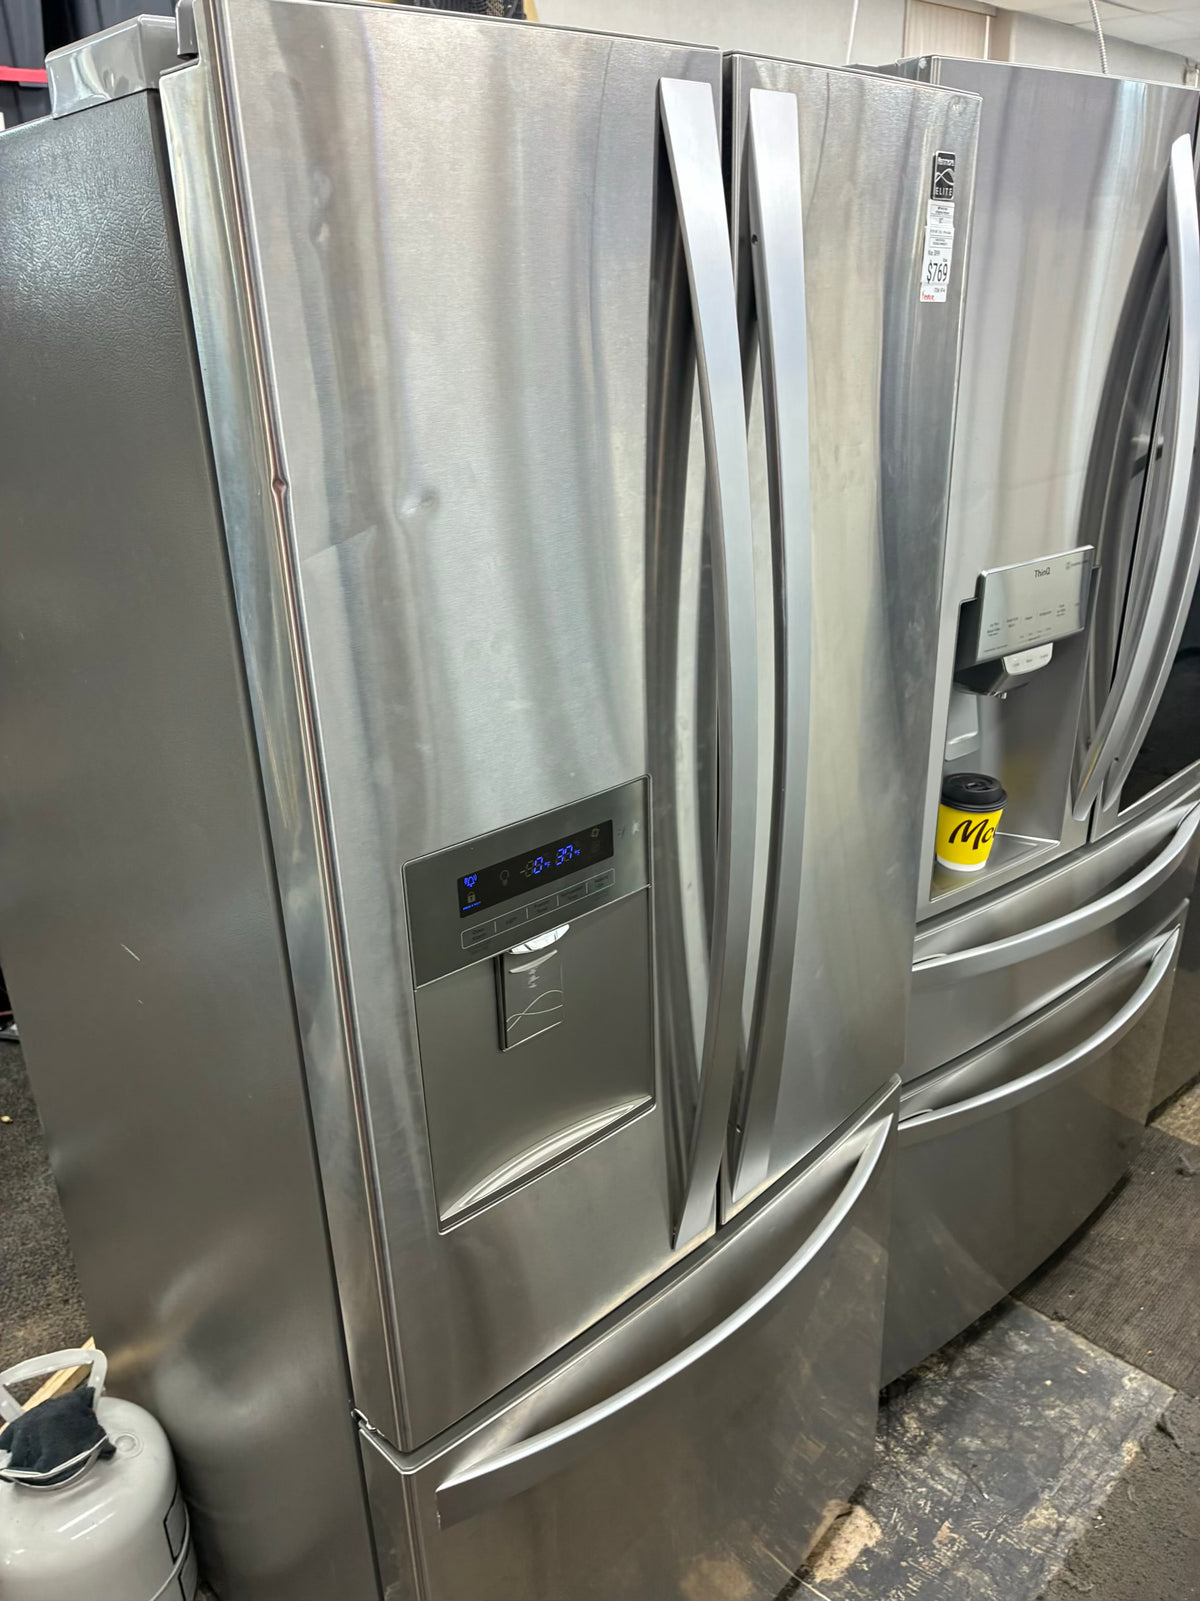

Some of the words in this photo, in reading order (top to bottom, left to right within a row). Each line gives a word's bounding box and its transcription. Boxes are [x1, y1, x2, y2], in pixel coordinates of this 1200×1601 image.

[935, 187, 953, 196] ELITE
[927, 261, 948, 284] $769
[1034, 567, 1051, 578] ThinQ
[948, 819, 996, 850] Mc
